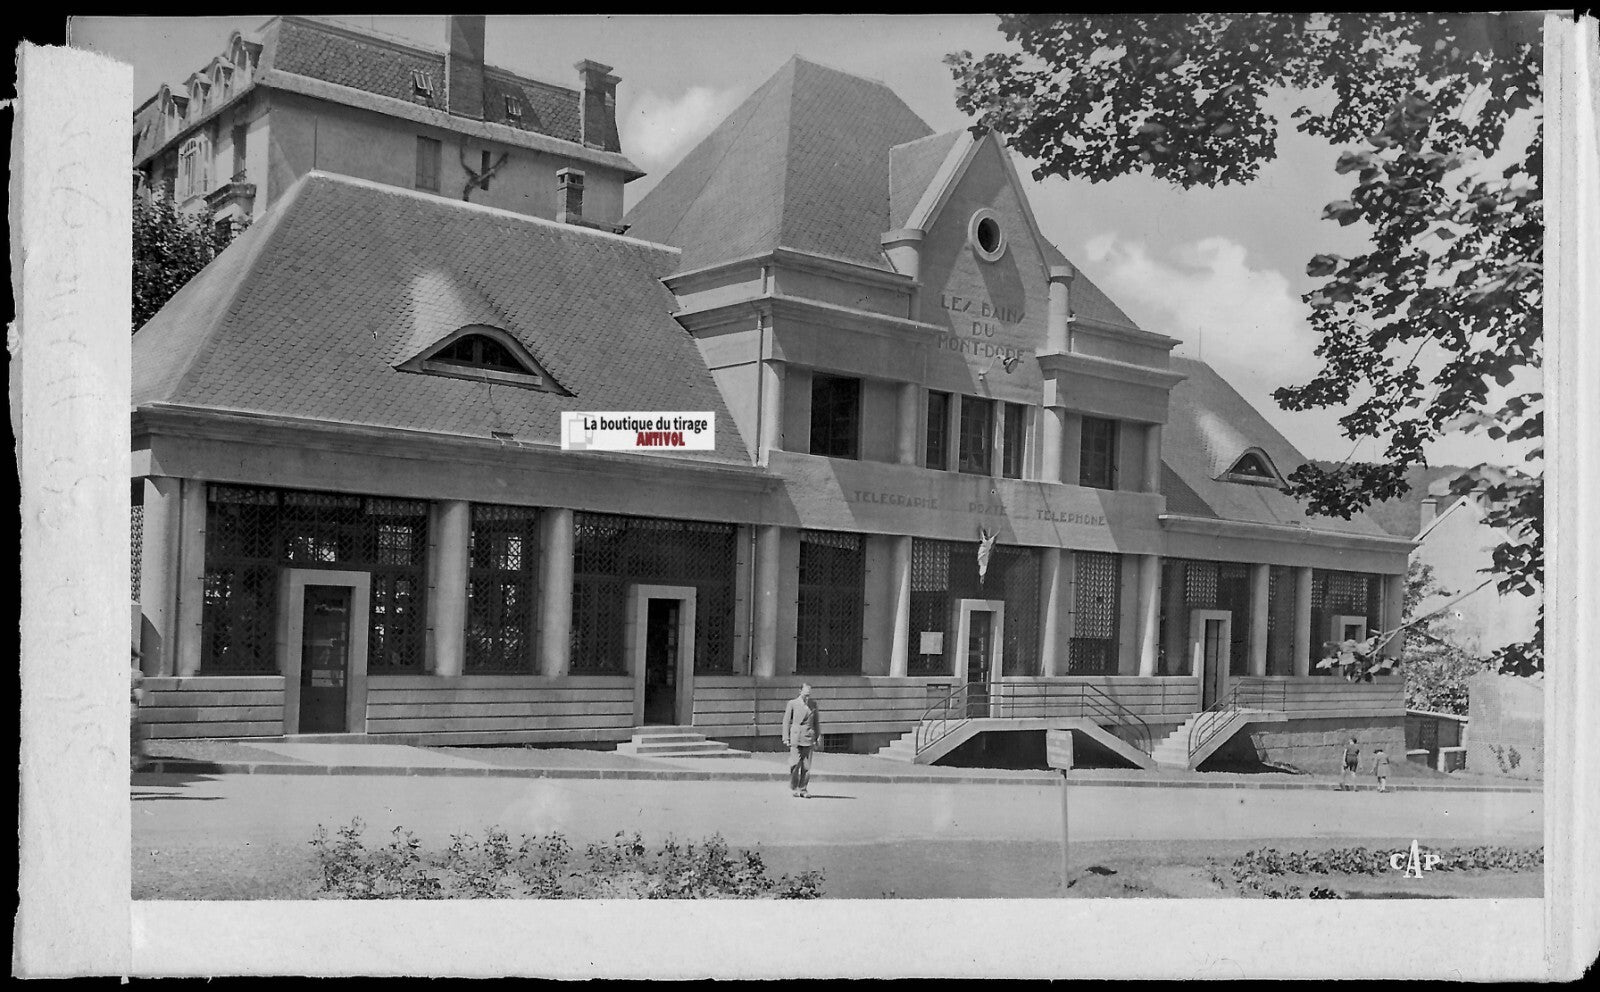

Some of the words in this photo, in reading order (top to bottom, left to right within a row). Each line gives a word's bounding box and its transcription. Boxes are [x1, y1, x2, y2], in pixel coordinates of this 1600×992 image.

[940, 294, 971, 313] LES
[981, 302, 1026, 324] BAINS
[972, 321, 995, 338] DU
[854, 490, 939, 510] TELEGRAPHE
[968, 502, 1007, 516] POSTE
[1036, 509, 1105, 526] TELEPHONE
